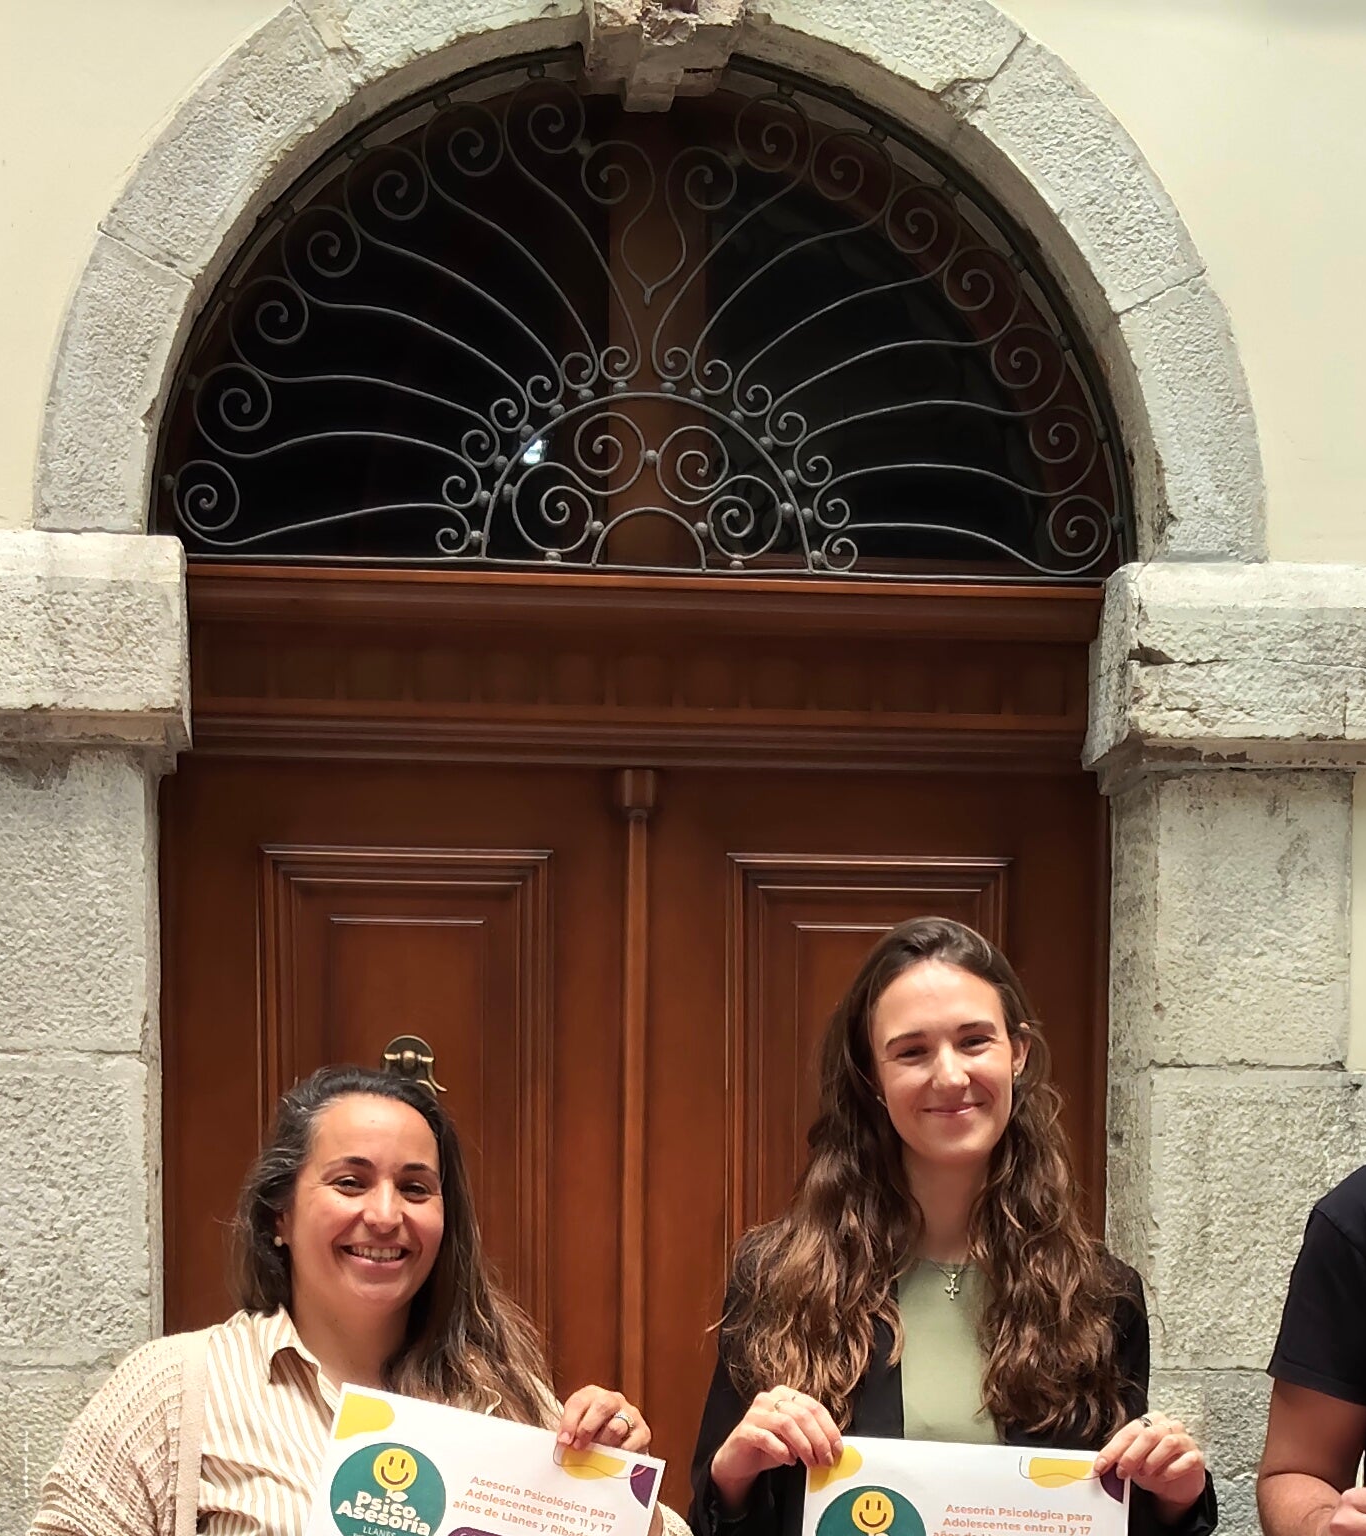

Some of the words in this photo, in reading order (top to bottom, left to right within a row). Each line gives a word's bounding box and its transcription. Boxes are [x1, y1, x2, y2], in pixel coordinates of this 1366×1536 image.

[355, 1490, 417, 1519] Psico
[465, 1488, 543, 1515] Adolescentes
[545, 1510, 575, 1524] entre
[470, 1475, 520, 1495] Asesoría
[522, 1489, 587, 1514] Psicológica
[590, 1508, 615, 1521] para
[335, 1499, 431, 1536] Asesoría
[453, 1499, 481, 1513] años
[501, 1512, 538, 1528] Llanes
[942, 1517, 1021, 1531] Adolescentes
[1024, 1523, 1055, 1533] entre
[1057, 1524, 1066, 1533] 11
[1079, 1526, 1091, 1535] 17
[944, 1503, 995, 1515] Asesoría
[998, 1507, 1064, 1521] Psicológica
[1066, 1513, 1093, 1523] para
